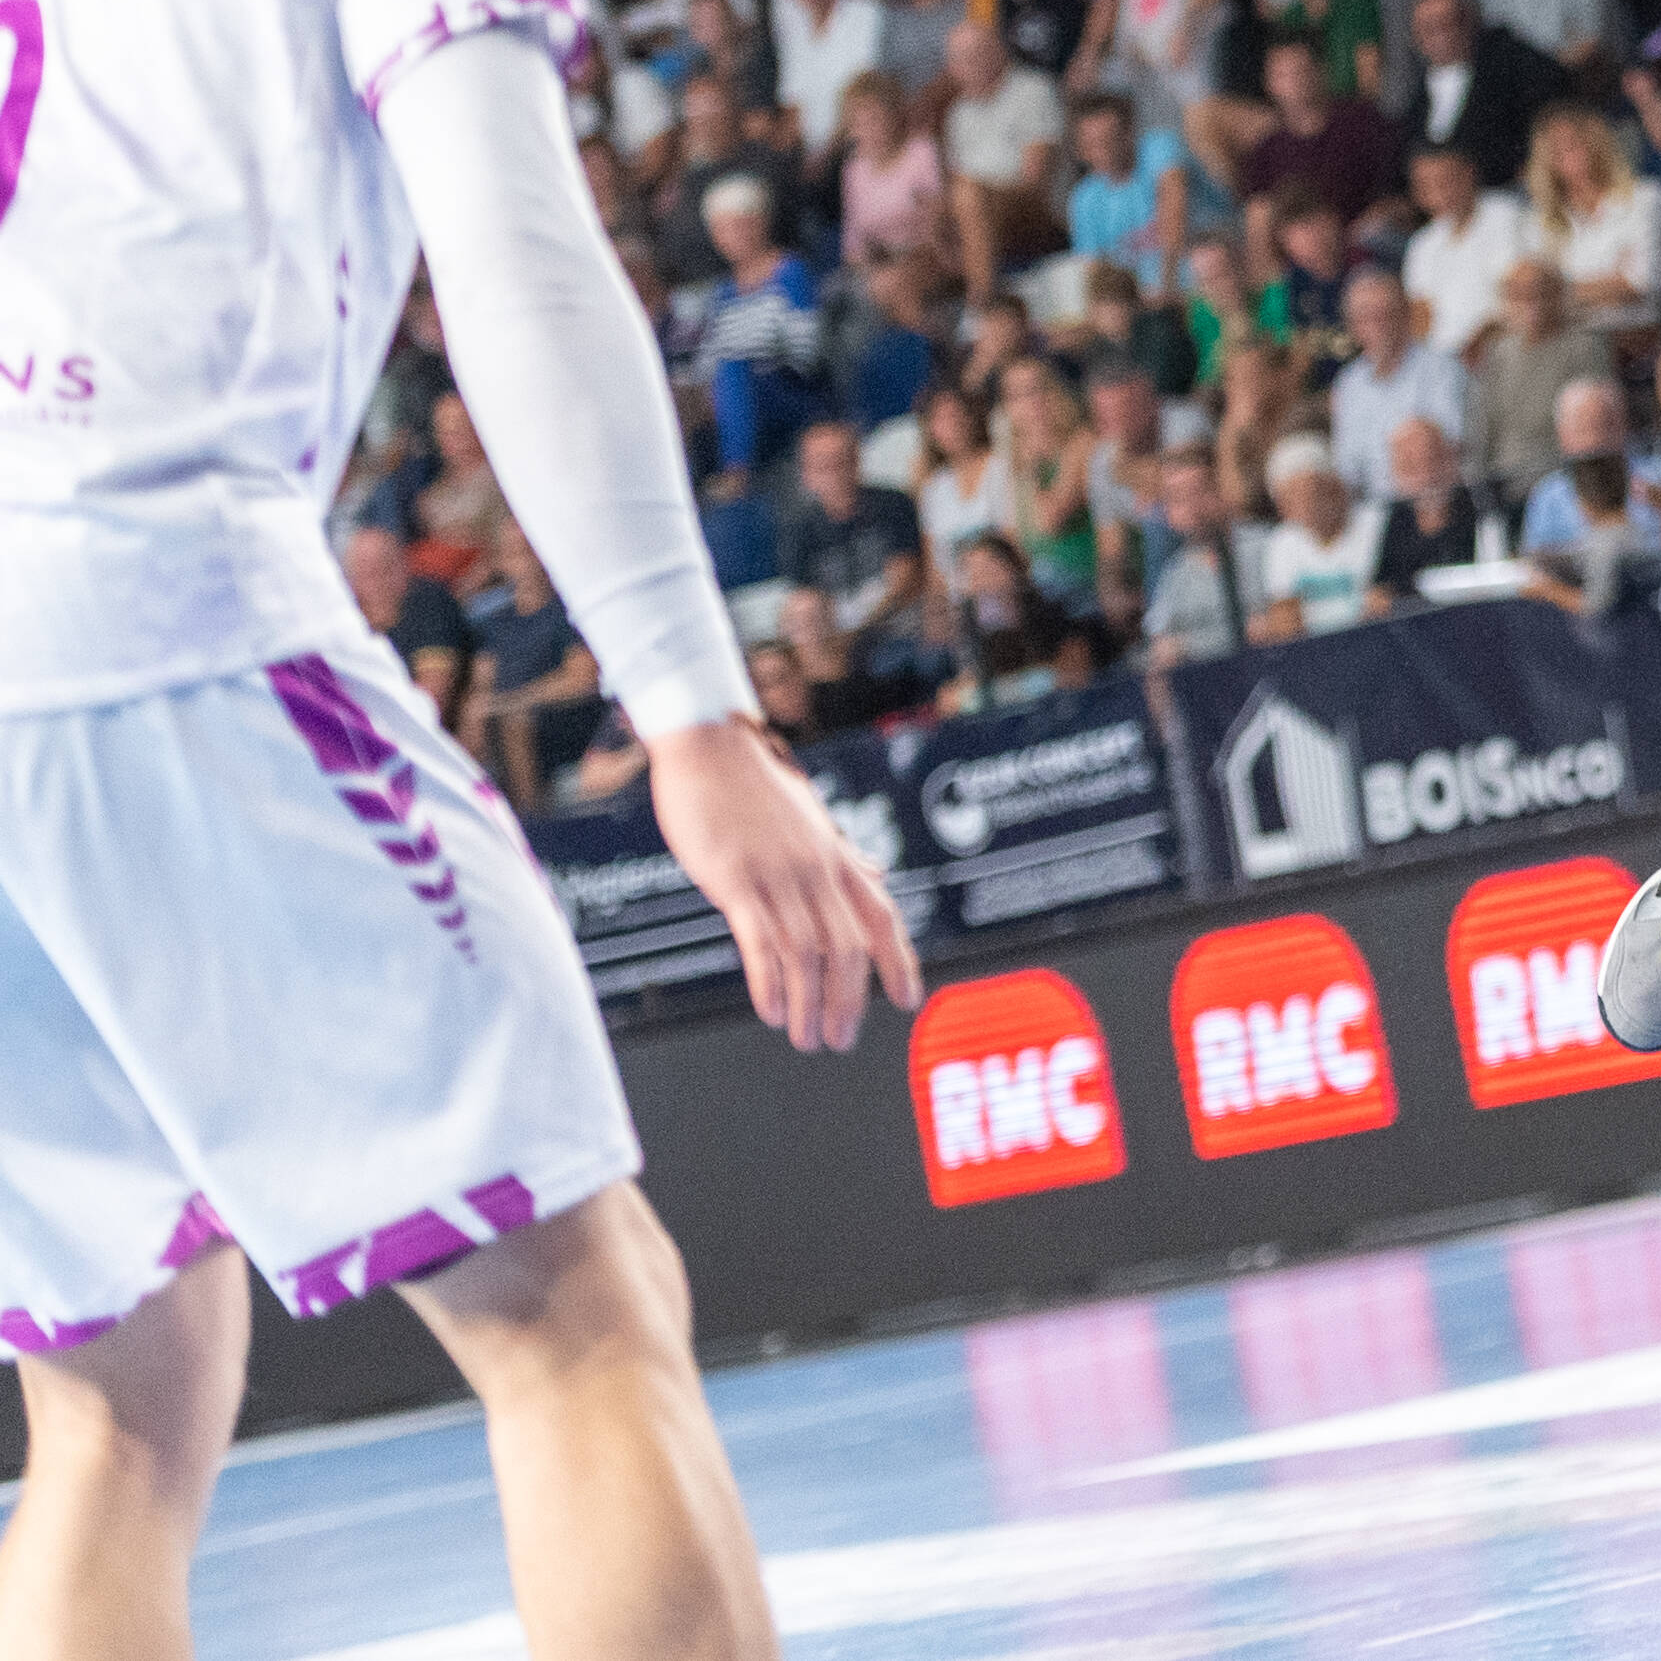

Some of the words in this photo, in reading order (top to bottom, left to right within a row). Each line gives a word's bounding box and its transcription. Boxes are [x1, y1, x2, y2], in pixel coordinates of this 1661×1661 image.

[1189, 981, 1378, 1119] RMC
[1467, 938, 1604, 1068] RM
[929, 1033, 1109, 1172] RMC
